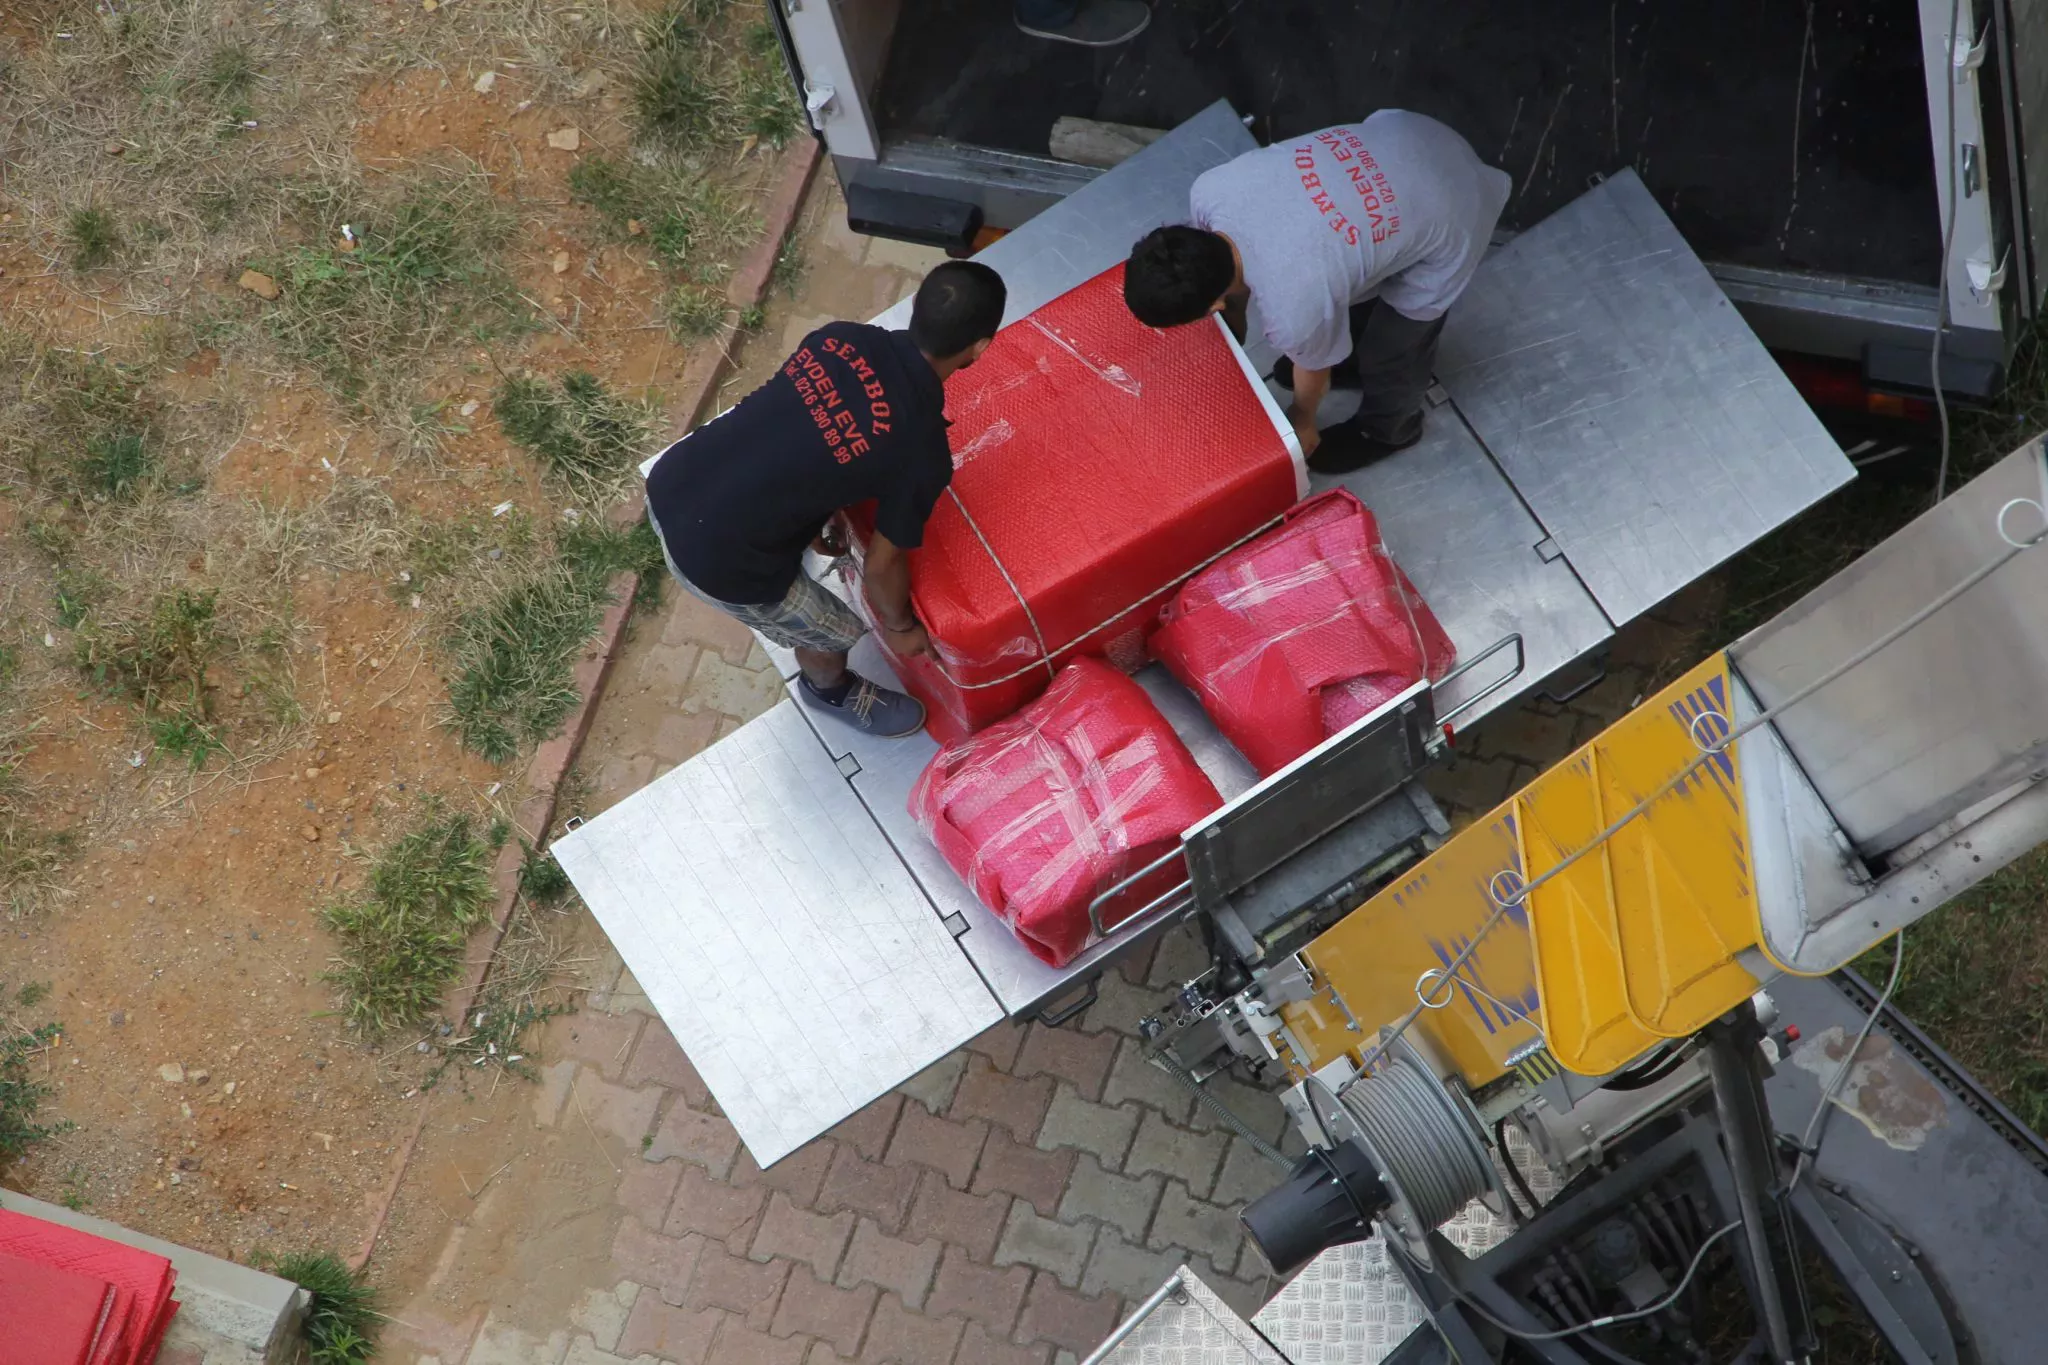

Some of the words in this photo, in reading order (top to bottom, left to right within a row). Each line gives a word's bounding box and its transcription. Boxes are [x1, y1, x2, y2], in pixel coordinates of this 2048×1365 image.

[1315, 132, 1353, 163] EVE
[1345, 136, 1364, 149] 89
[1356, 150, 1379, 171] 390
[1295, 145, 1361, 246] SEMBOL
[1346, 166, 1386, 245] EVDEN
[1372, 173, 1395, 204] 0216
[794, 377, 818, 405] 0216
[810, 405, 832, 429] 390
[824, 428, 842, 447] 89
[834, 446, 851, 464] 99
[795, 347, 843, 409] EVDEN
[834, 410, 870, 456] EVE
[821, 338, 891, 435] SEMBOL
